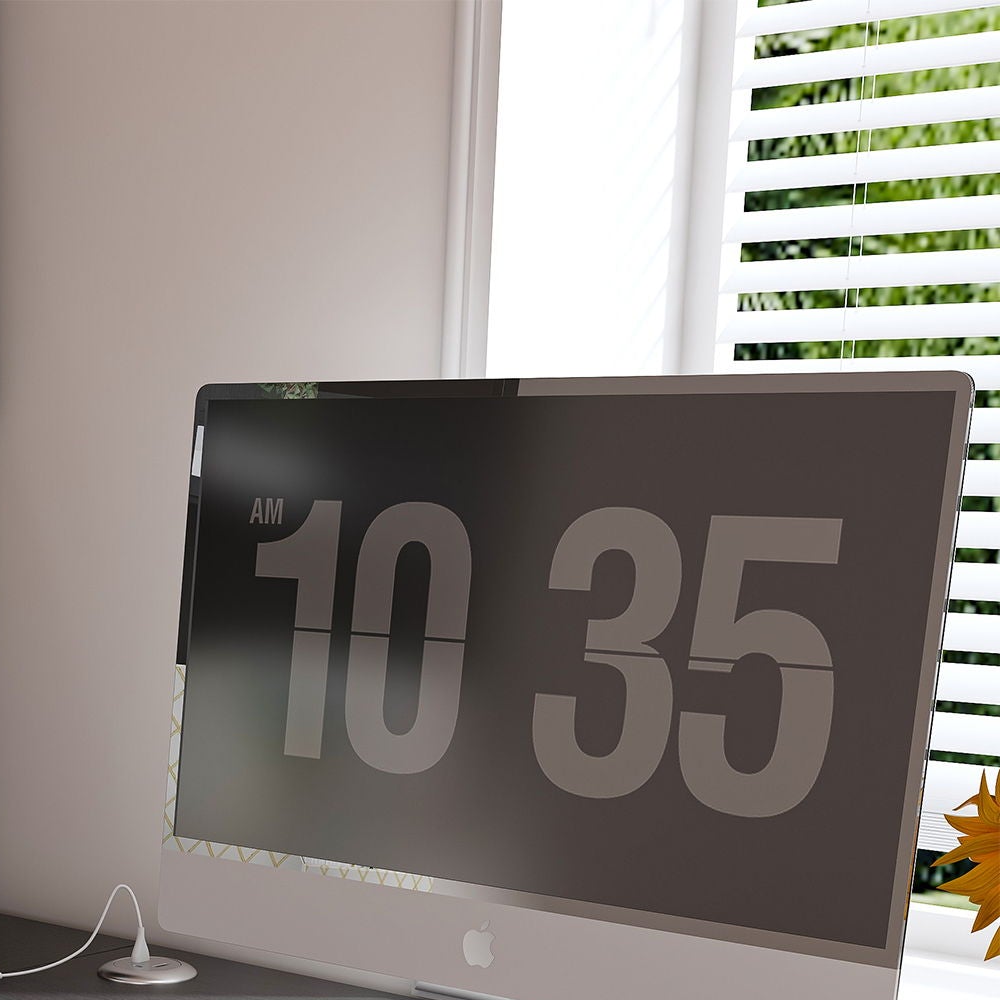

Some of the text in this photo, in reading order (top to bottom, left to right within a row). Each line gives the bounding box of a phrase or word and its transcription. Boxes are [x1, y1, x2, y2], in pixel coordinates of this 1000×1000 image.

[250, 498, 284, 524] AM
[254, 500, 844, 818] 10 35
